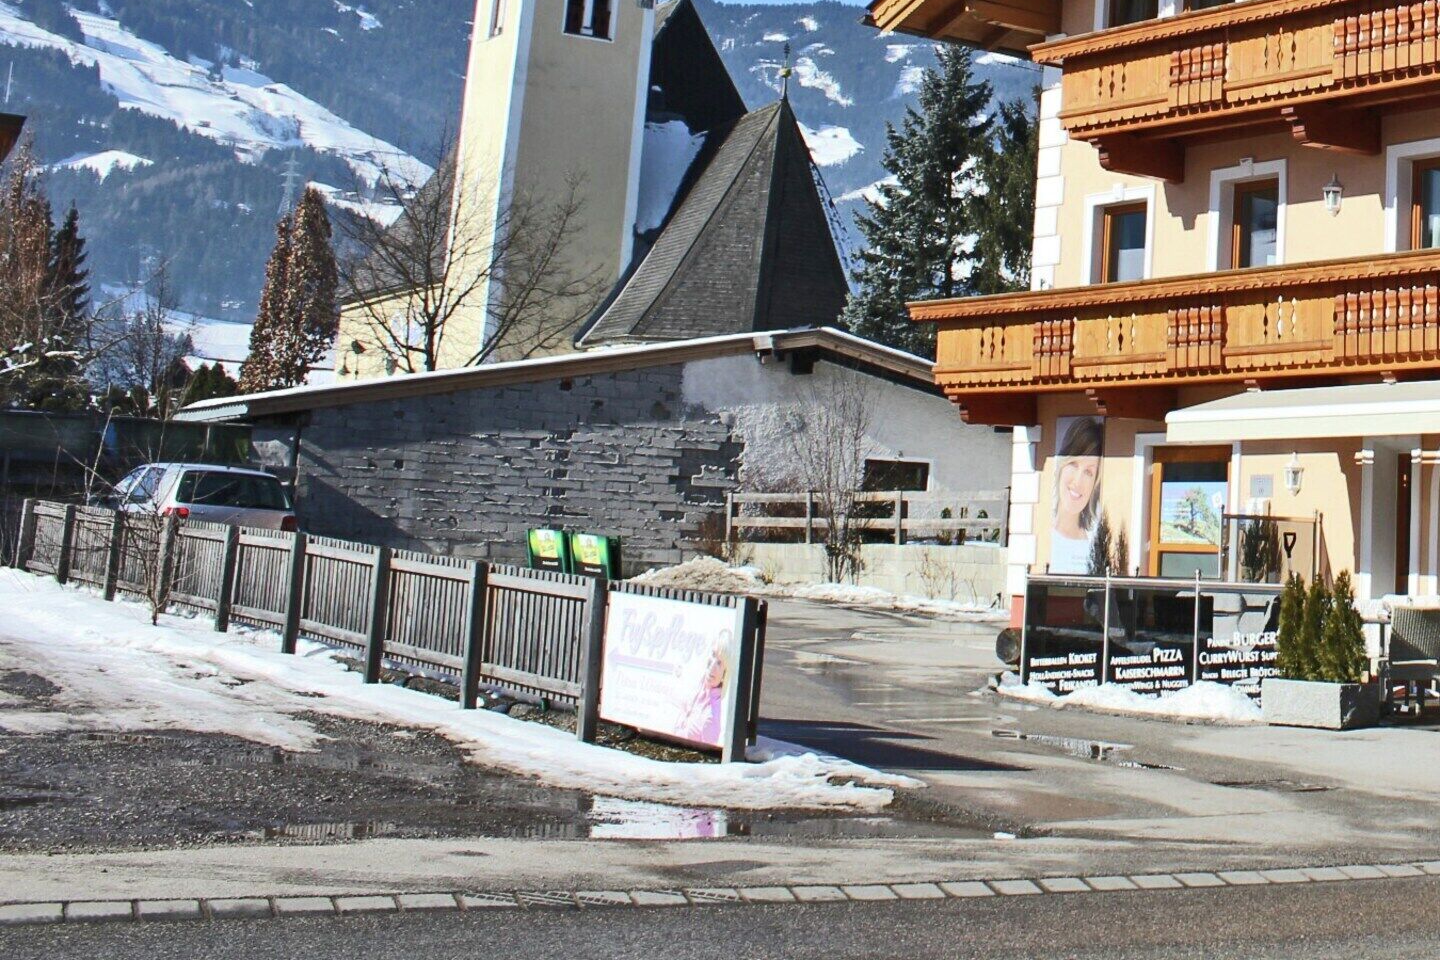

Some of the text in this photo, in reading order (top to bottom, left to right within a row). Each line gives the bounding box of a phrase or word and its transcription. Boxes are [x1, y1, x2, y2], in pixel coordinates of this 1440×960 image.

[1069, 653, 1098, 665] KROKET
[1153, 647, 1183, 663] PIZZA
[1198, 650, 1260, 665] CURRYWURST
